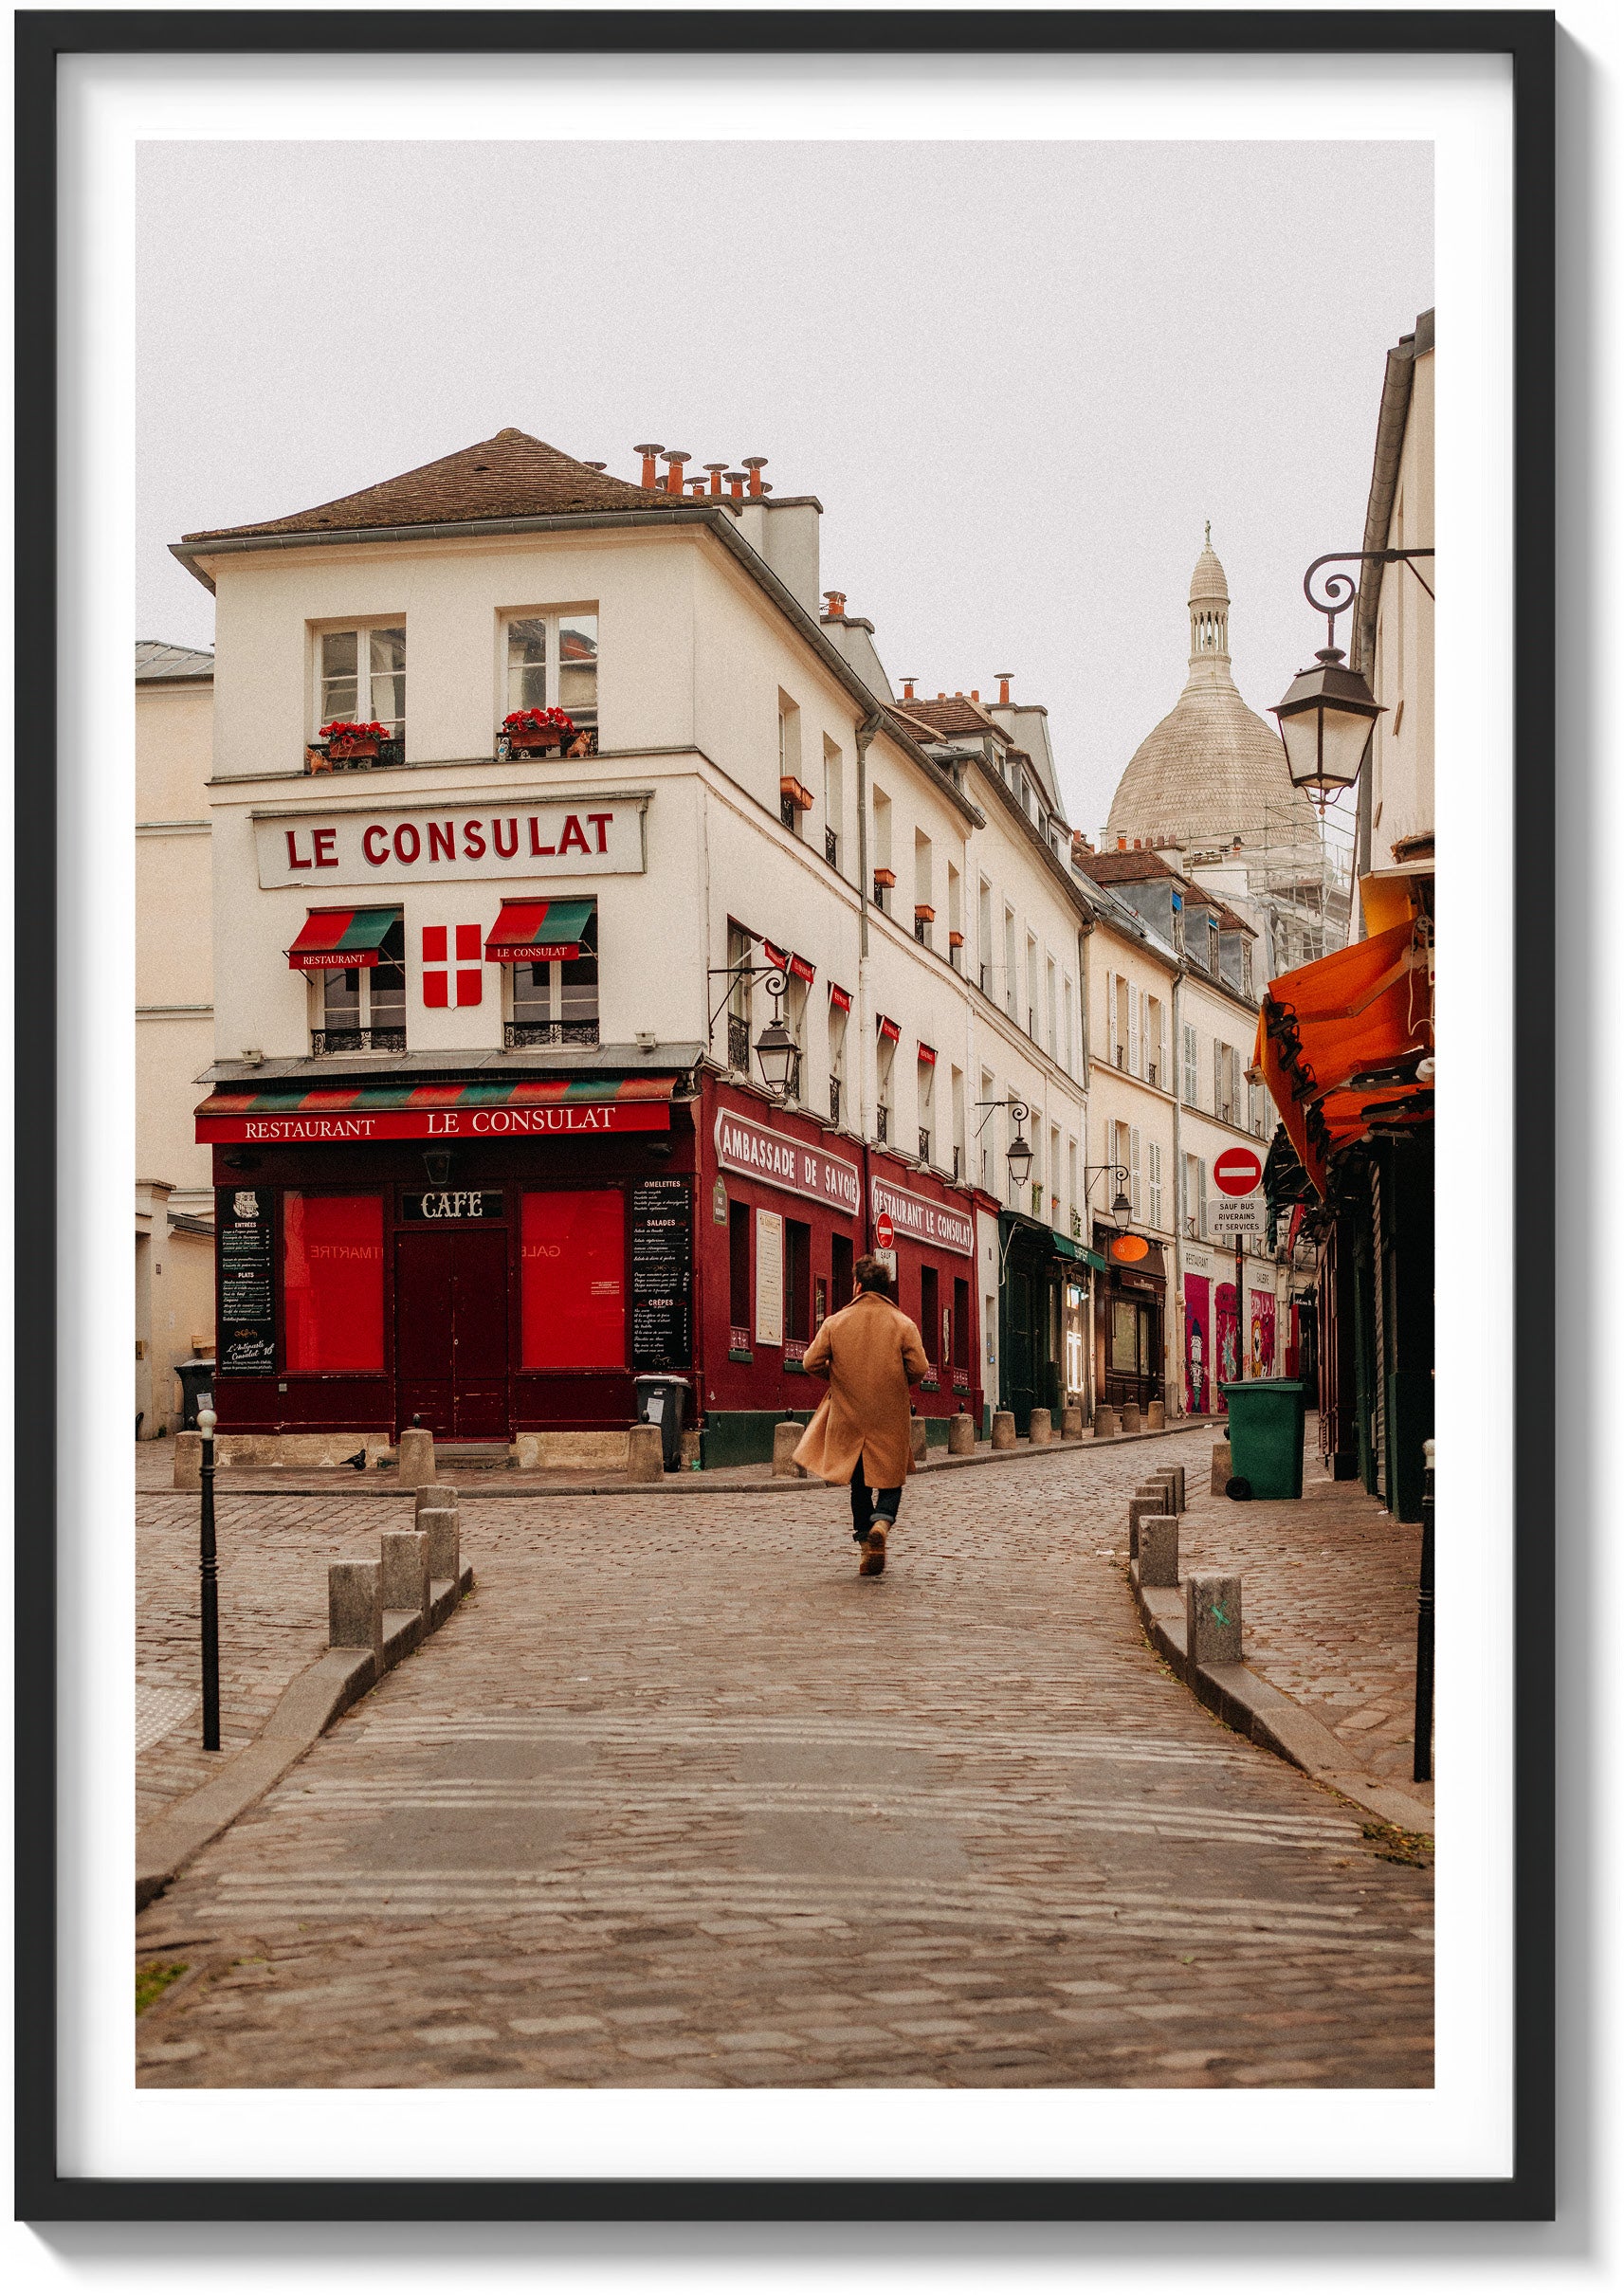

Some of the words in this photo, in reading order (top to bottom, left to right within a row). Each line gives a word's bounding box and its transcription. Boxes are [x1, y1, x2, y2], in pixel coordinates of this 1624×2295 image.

[284, 828, 339, 870] LE
[361, 812, 613, 866] CONSULAT
[302, 954, 366, 965] RESTAURANT
[497, 948, 510, 957] LE
[513, 947, 568, 957] CONSULAT
[245, 1120, 375, 1138] RESTAURANT
[427, 1113, 460, 1134] LE
[472, 1107, 616, 1132] CONSULAT
[722, 1124, 795, 1180] AMBASSADE
[804, 1155, 817, 1188] DE
[825, 1164, 857, 1205] SAVOIE
[420, 1192, 483, 1218] CAFE
[873, 1188, 924, 1230] RESTAURANT
[925, 1210, 935, 1235] LE
[938, 1214, 971, 1248] CONSULAT
